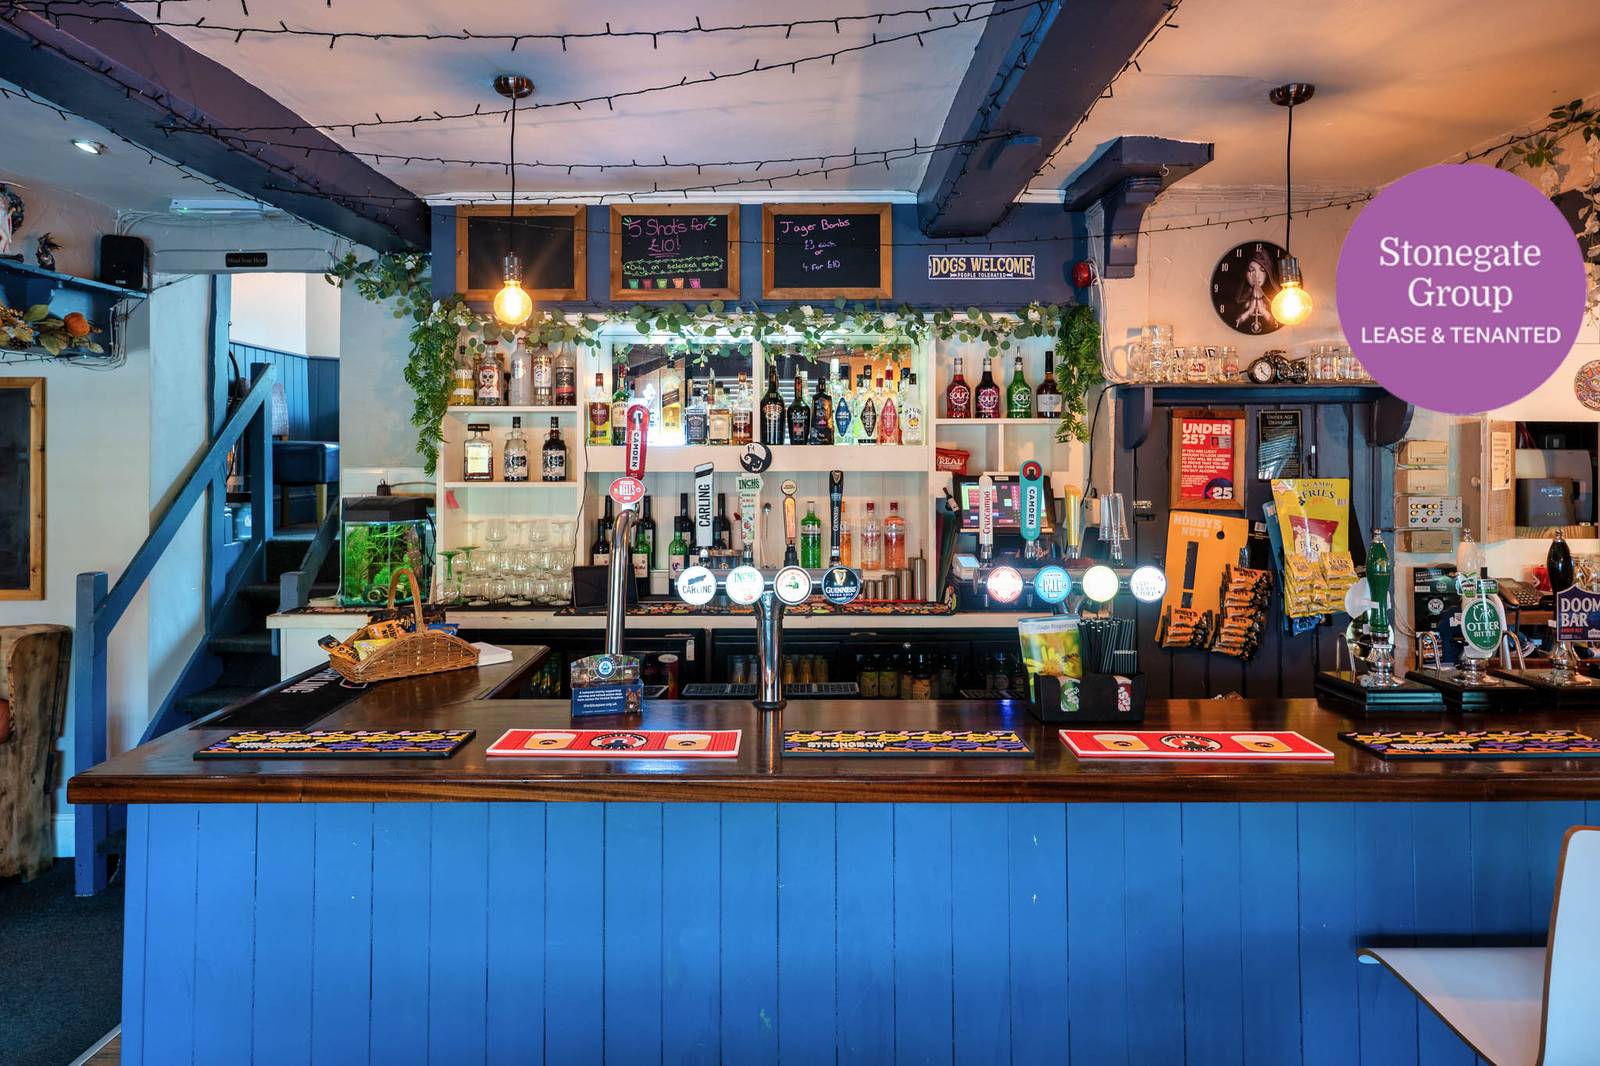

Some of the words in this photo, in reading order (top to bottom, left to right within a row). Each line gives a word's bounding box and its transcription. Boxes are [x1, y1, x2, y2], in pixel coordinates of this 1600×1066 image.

[628, 219, 641, 237] 5
[690, 217, 709, 230] for
[780, 221, 816, 236] Jager
[821, 218, 850, 230] Bombs
[1255, 243, 1262, 252] 12
[1236, 249, 1242, 258] 11
[932, 257, 966, 276] DOGS
[970, 257, 1032, 276] WELCOME
[1222, 263, 1229, 272] 10
[1214, 284, 1219, 293] 9
[1220, 304, 1225, 313] 8
[1182, 423, 1232, 434] UNDER
[1182, 434, 1206, 444] 25?
[631, 432, 641, 468] CAMDEN
[1212, 486, 1232, 499] 25
[1302, 489, 1336, 498] FRIES
[698, 484, 710, 527] CARLING
[1561, 597, 1600, 612] DOOM
[1561, 612, 1589, 627] BAR
[1467, 621, 1499, 631] OTTER
